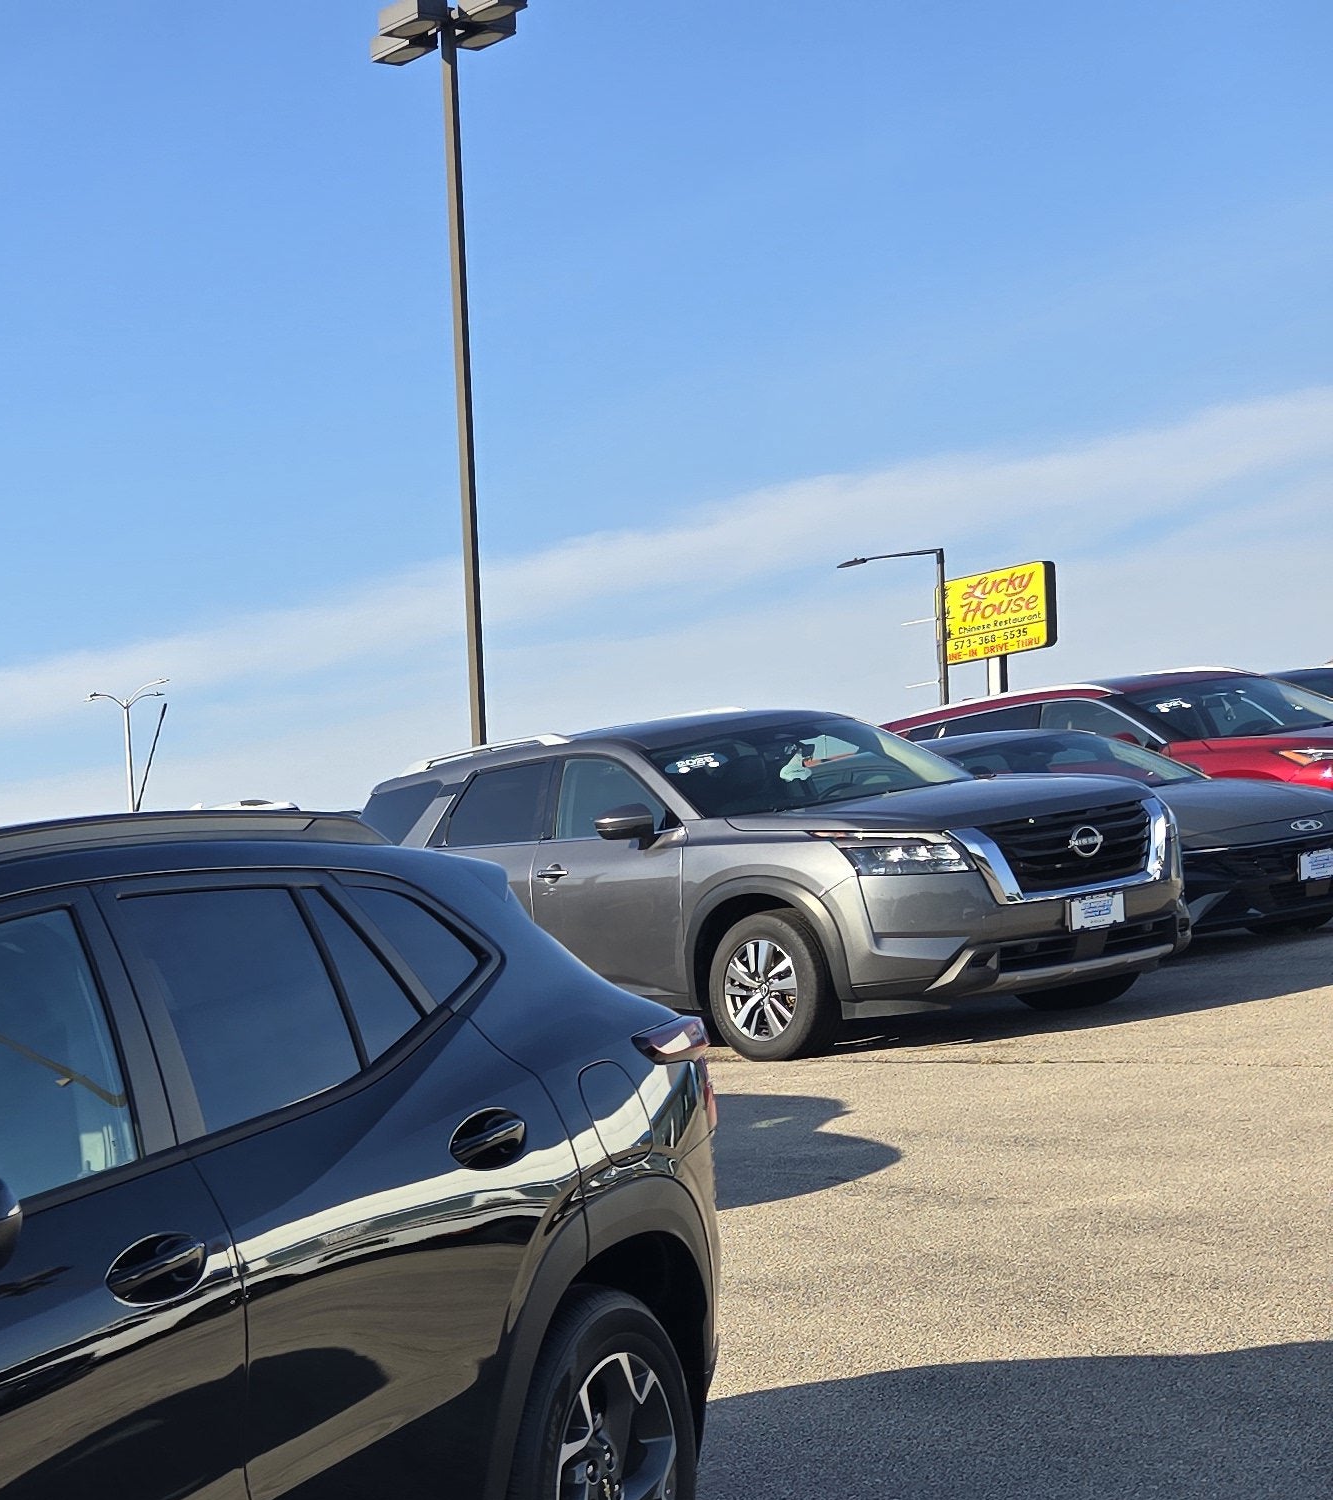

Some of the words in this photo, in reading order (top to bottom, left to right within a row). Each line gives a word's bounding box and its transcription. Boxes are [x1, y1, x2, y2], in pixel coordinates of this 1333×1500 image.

[962, 572, 1035, 599] Lucky
[958, 623, 991, 635] Chinese
[993, 612, 1042, 627] Restaurant
[947, 648, 978, 662] INE-IN
[984, 636, 1040, 654] DRIVE-THRU
